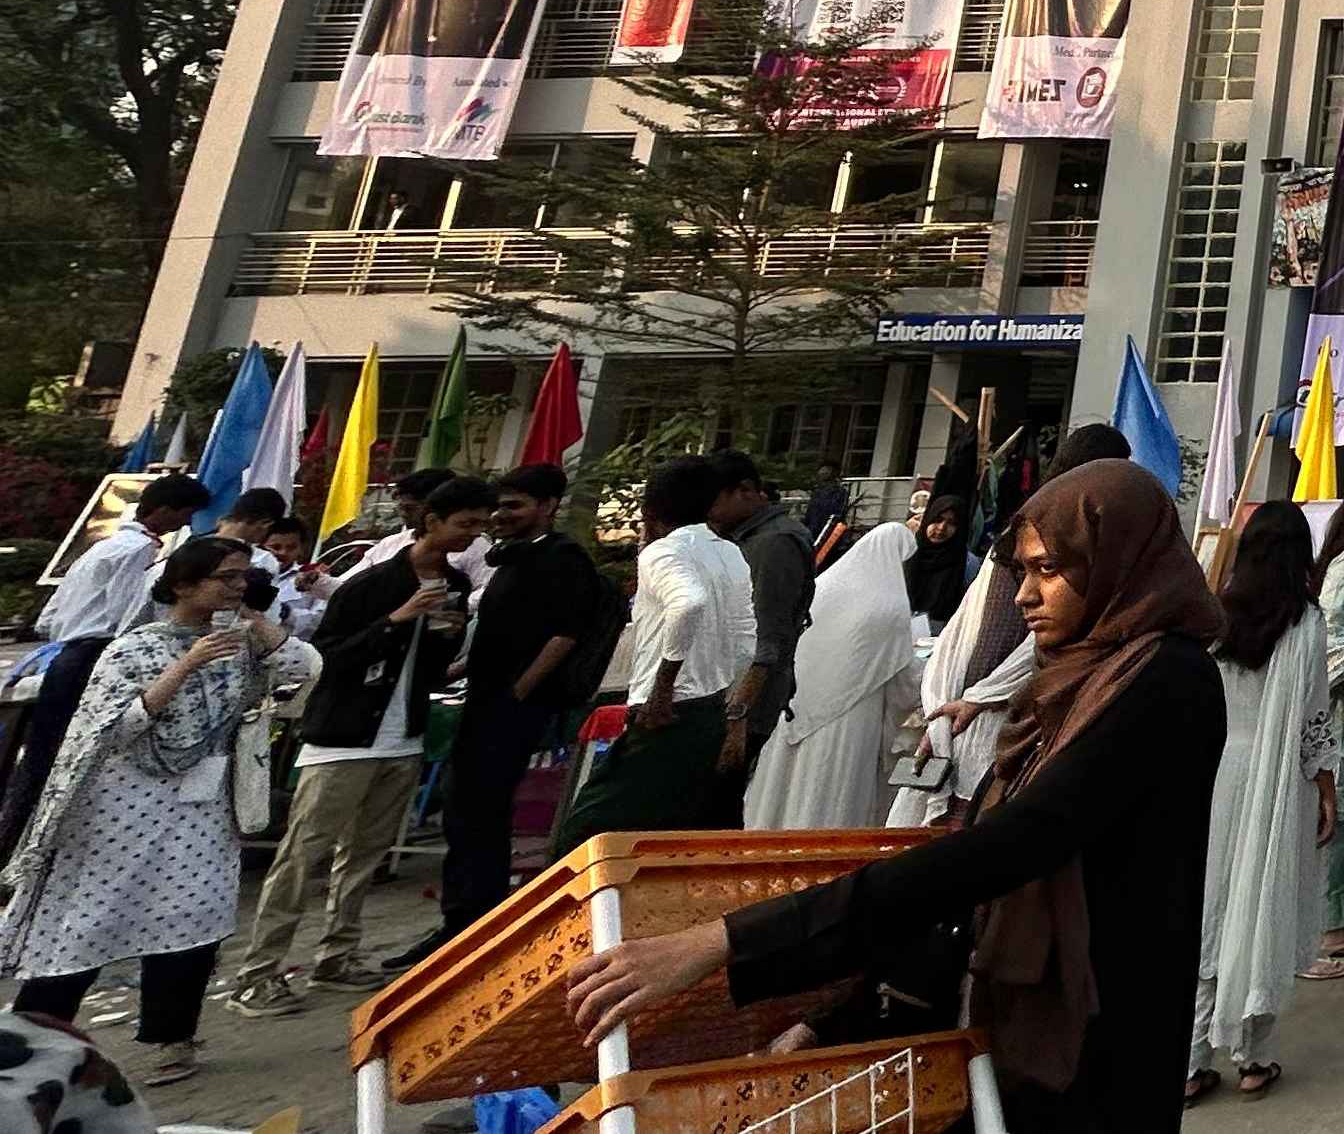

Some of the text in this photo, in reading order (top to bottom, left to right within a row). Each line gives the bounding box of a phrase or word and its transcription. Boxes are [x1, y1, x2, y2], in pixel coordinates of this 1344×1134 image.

[877, 319, 1084, 342] Education for Humaniza
